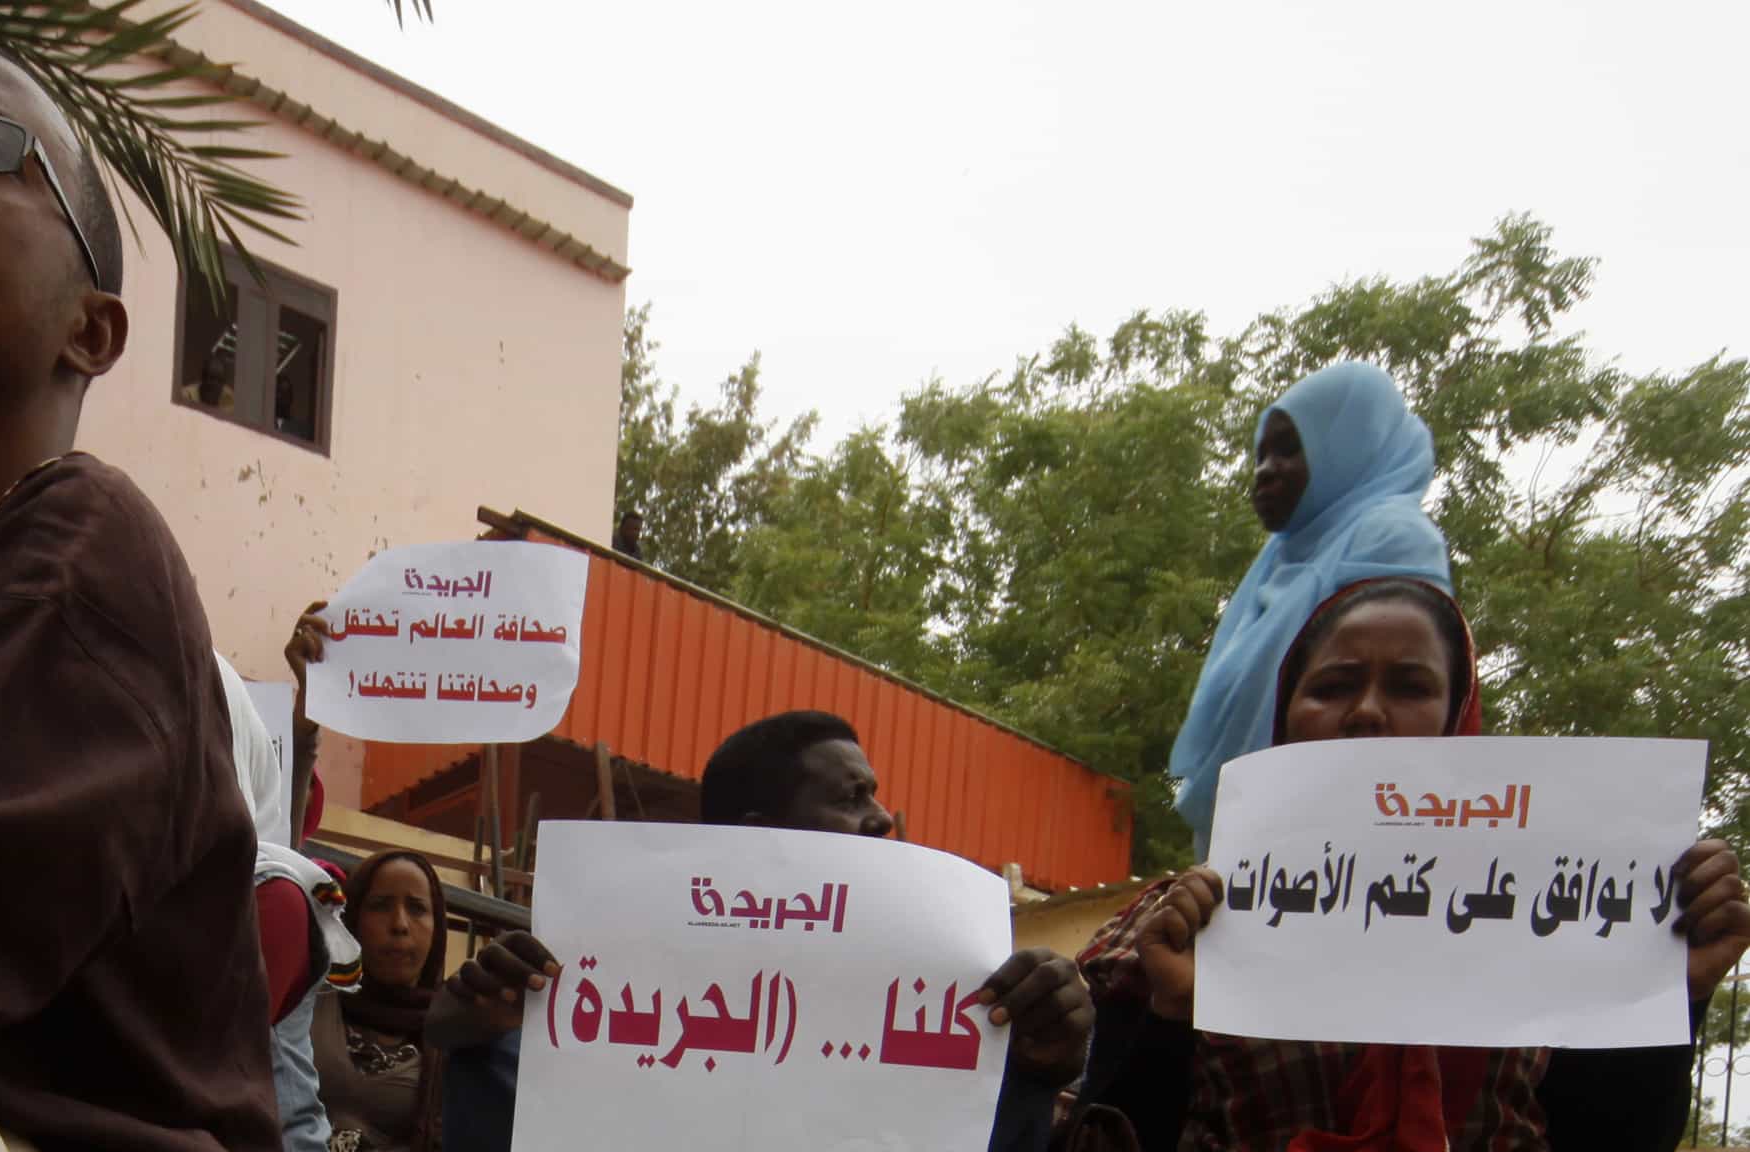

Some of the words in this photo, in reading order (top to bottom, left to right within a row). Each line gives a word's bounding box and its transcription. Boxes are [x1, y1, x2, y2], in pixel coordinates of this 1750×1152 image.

[404, 568, 492, 599] الجريدة
[329, 607, 400, 643] تحتفل
[409, 612, 484, 645] العالم
[493, 613, 567, 645] صحافة
[436, 672, 538, 710] وصحافتنا
[1375, 783, 1531, 829] الجريدة
[691, 877, 849, 933] الجريدة
[1226, 841, 1356, 928] الأصوات
[1365, 852, 1438, 932] كتم
[1445, 856, 1517, 935] على
[1530, 855, 1637, 939] نوافق
[1649, 864, 1675, 926] لا
